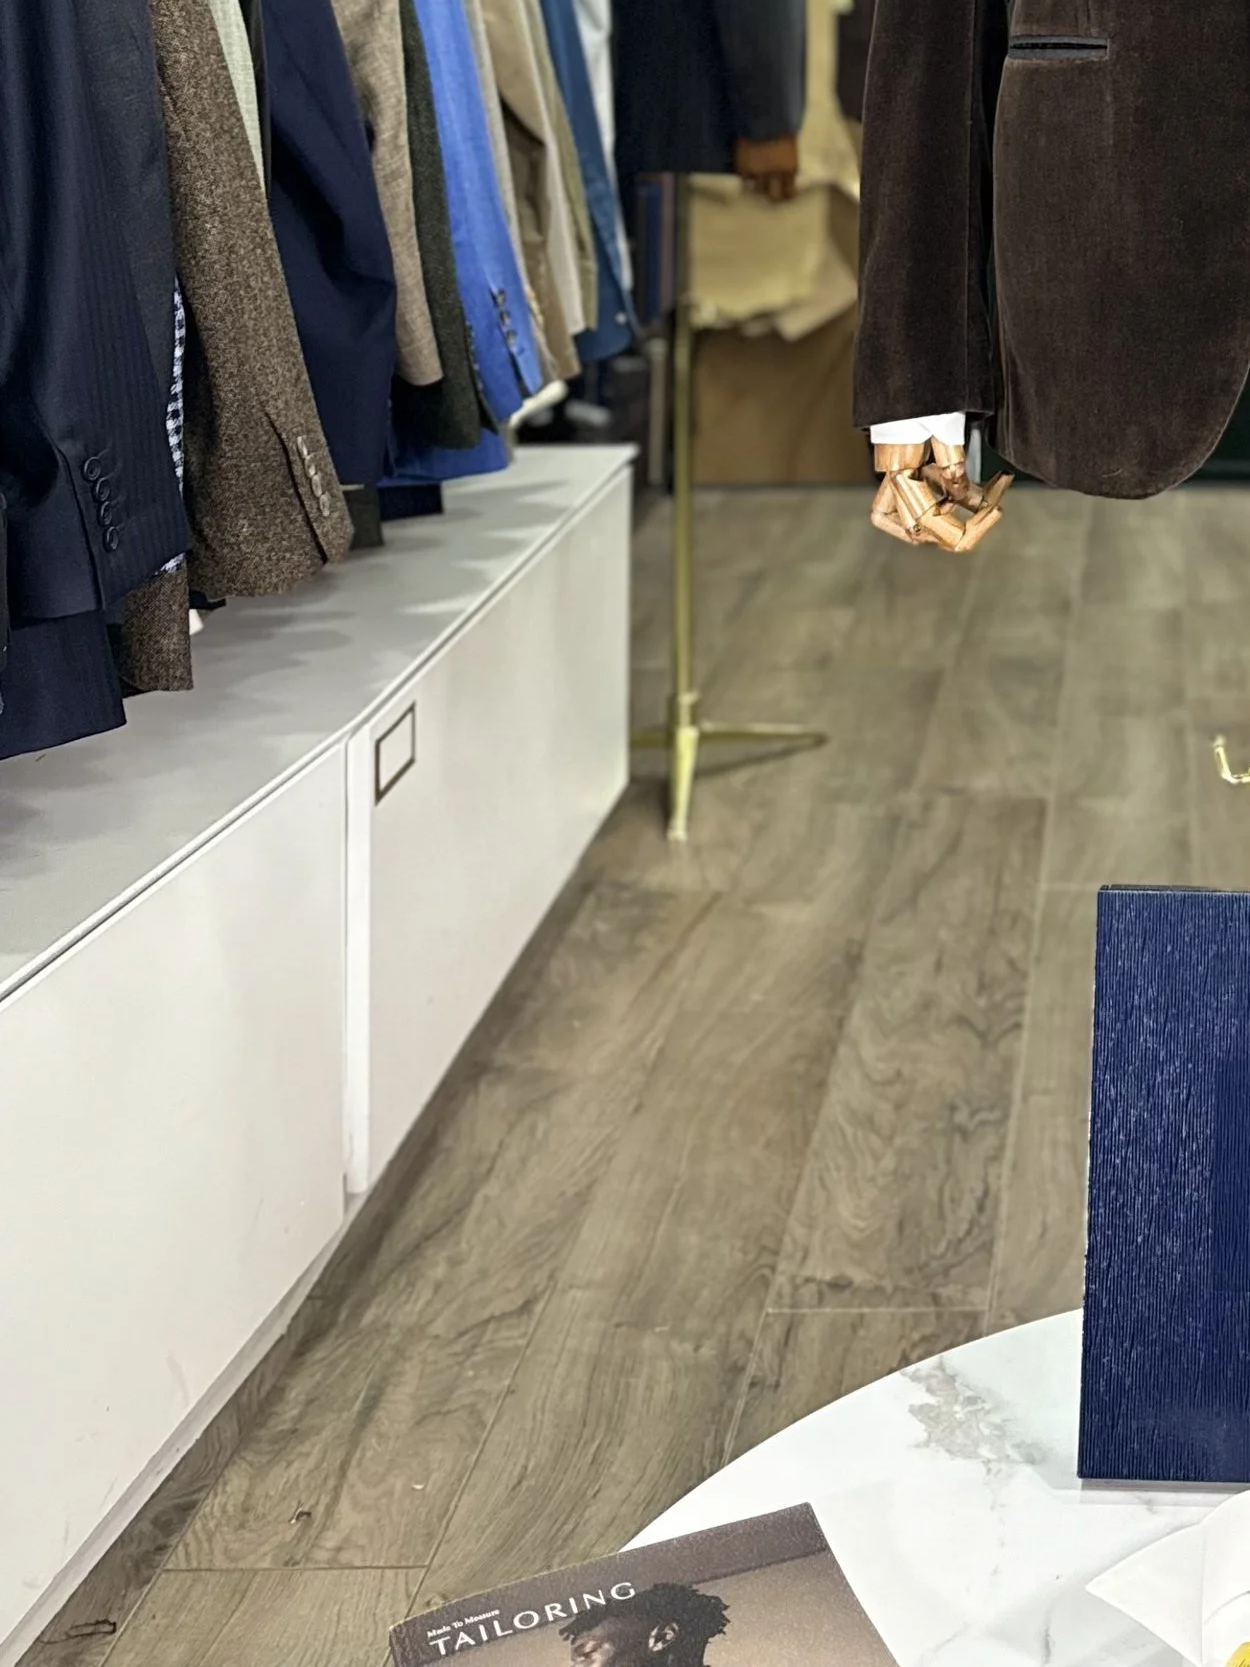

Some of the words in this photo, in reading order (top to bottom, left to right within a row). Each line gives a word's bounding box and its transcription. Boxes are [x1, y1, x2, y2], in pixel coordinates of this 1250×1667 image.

[427, 1625, 451, 1638] Made
[452, 1619, 463, 1629] To
[464, 1609, 500, 1624] Measure
[429, 1582, 636, 1655] TAILORING
